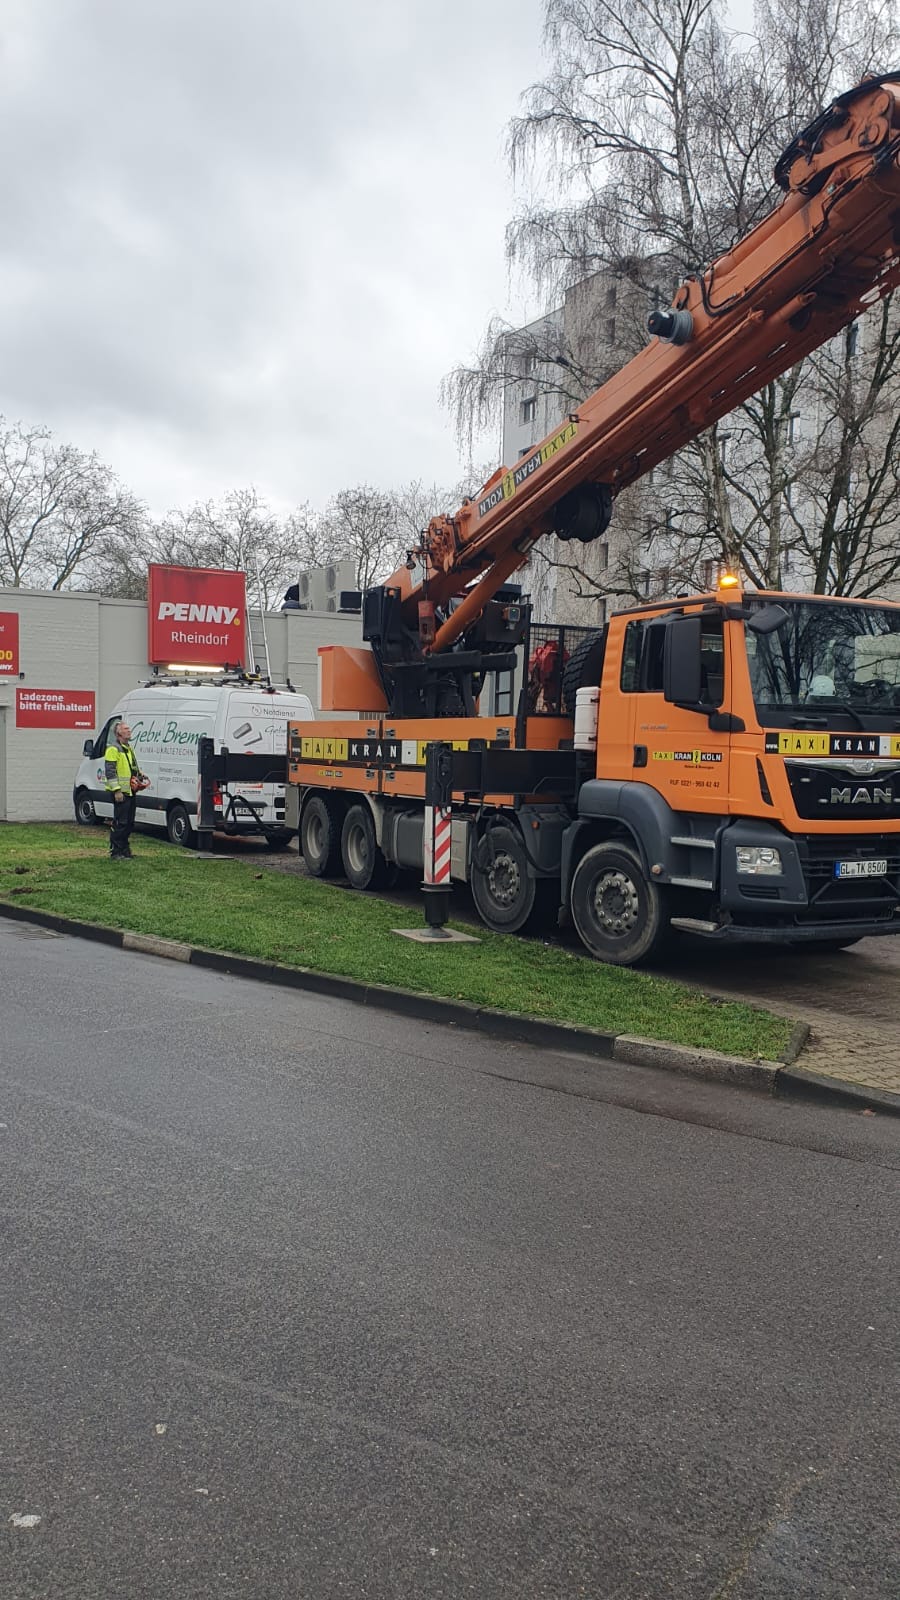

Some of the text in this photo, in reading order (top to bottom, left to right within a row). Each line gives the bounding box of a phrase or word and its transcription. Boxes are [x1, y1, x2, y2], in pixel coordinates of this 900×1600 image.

[480, 423, 577, 516] TAXI KRAN KÖLN
[171, 631, 229, 646] Rheindorf
[20, 693, 64, 702] Ladezone
[20, 702, 92, 712] bitte freihalten!
[263, 708, 296, 717] Notdienst
[304, 742, 344, 756] TAXI
[351, 743, 397, 758] KRAN
[783, 738, 825, 750] TAXI
[834, 739, 876, 751] KRAN
[702, 753, 721, 761] KÖLN
[831, 788, 892, 804] MAN
[840, 861, 886, 875] GL TK 8500
